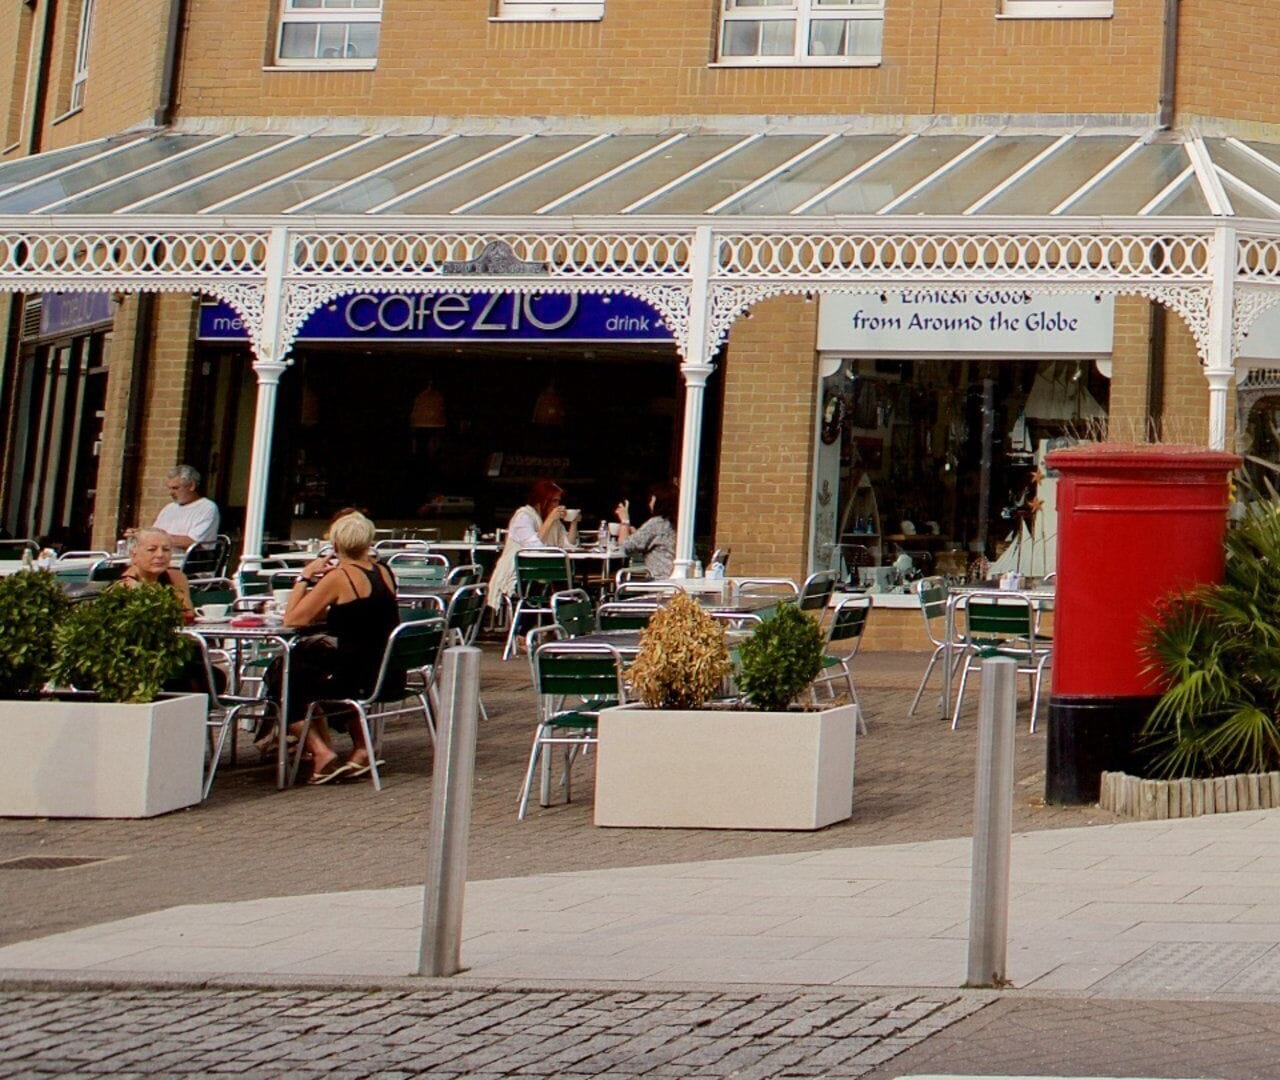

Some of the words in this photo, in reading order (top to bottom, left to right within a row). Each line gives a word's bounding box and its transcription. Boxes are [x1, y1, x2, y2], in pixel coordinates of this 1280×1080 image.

[606, 315, 650, 331] drink
[853, 310, 901, 331] from
[908, 312, 982, 331] Around
[989, 311, 1020, 331] the
[1025, 311, 1078, 332] Globe
